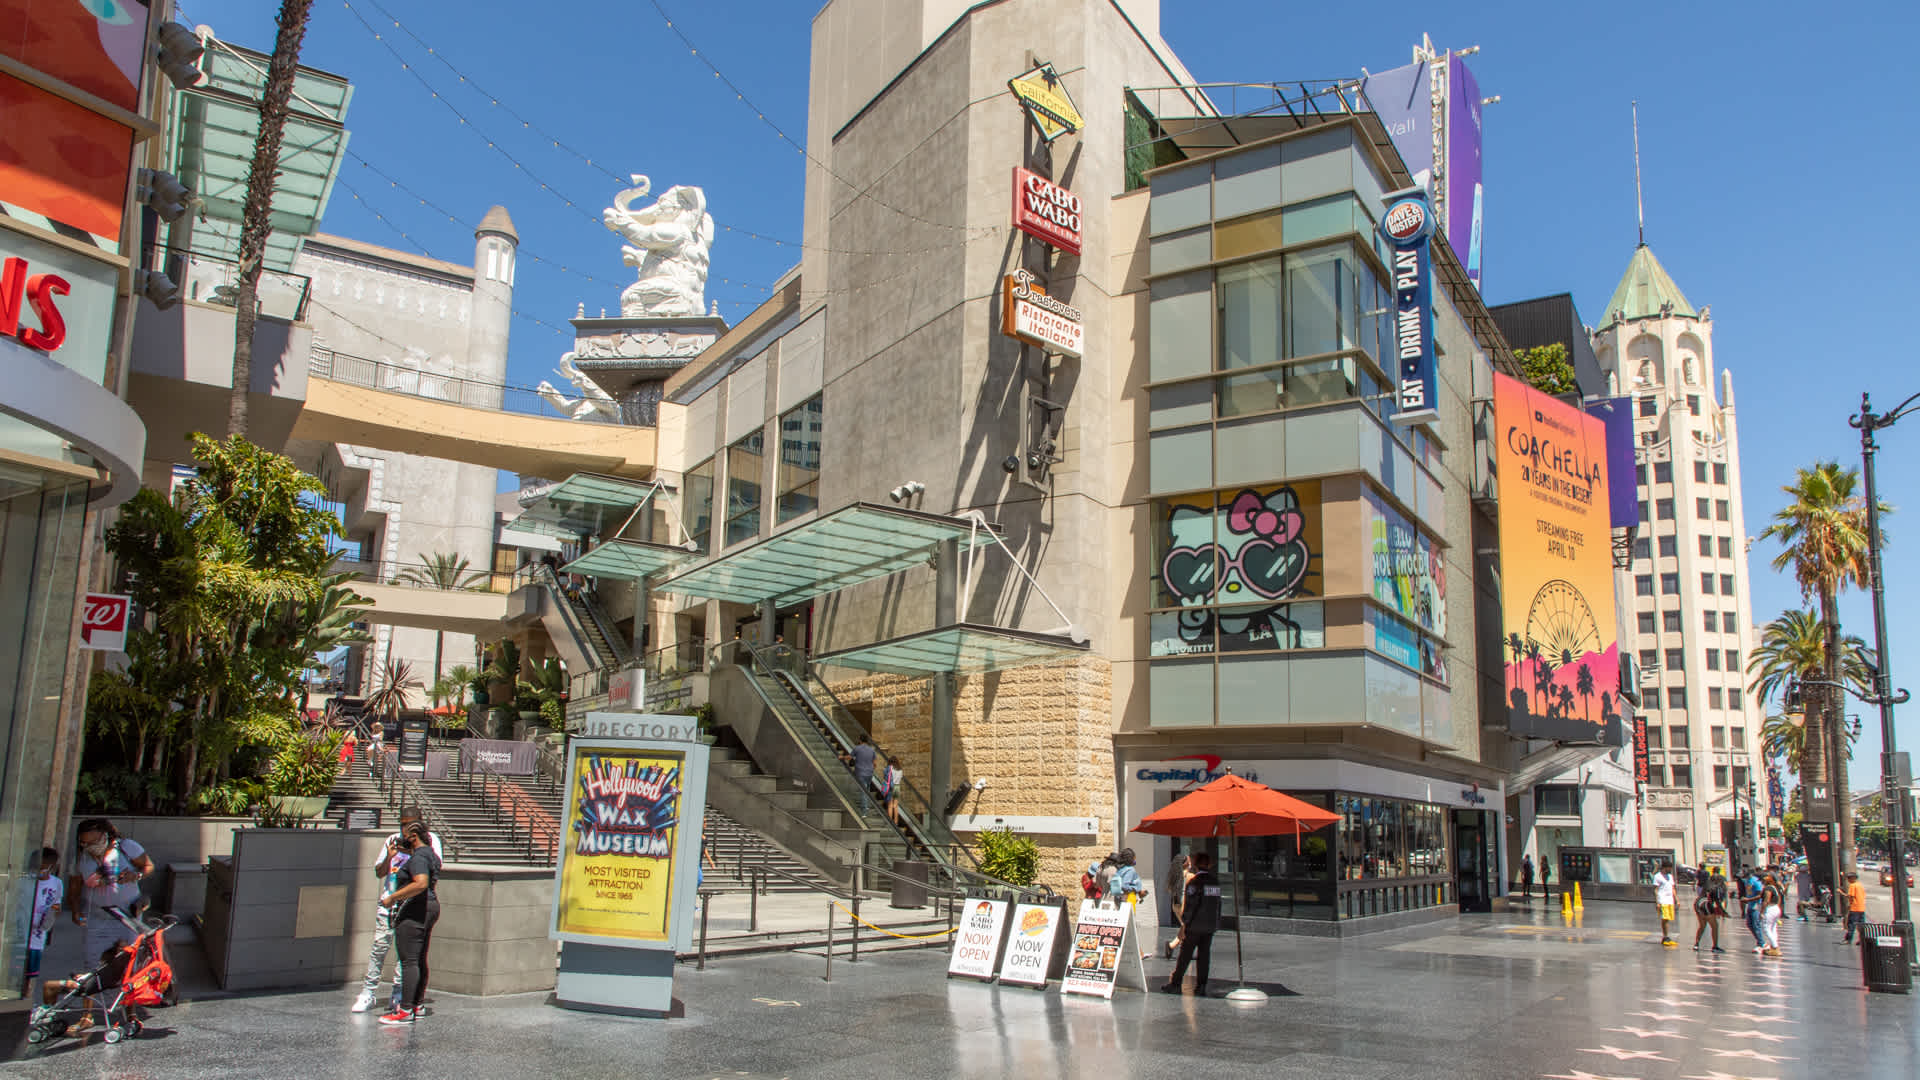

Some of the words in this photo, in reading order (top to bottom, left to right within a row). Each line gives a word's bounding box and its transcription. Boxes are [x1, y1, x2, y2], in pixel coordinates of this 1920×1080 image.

[1027, 175, 1081, 214] CABO
[1026, 192, 1081, 232] WABO
[1389, 205, 1412, 225] DAVE
[1025, 213, 1081, 243] CANTINA
[1396, 250, 1419, 291] PLAY
[1022, 304, 1081, 338] Ristorante
[1029, 320, 1074, 348] Italiano
[1399, 306, 1422, 360] DRINK
[1402, 379, 1424, 409] EAT
[1508, 426, 1602, 490] COACHELLA
[1521, 464, 1530, 482] 20
[1532, 467, 1552, 490] YEARS
[1552, 476, 1560, 494] IN
[1560, 479, 1571, 498] THE
[1572, 483, 1593, 507] DESERT
[1536, 519, 1569, 542] STREAMING
[1569, 530, 1584, 547] FREE
[1548, 539, 1567, 559] APRIL
[1567, 545, 1576, 561] 10
[578, 721, 695, 741] DIRECTORY
[586, 765, 667, 809] Hollywood
[1813, 786, 1827, 799] M
[596, 802, 648, 827] WAX
[577, 828, 669, 857] MUSEUM
[584, 866, 612, 877] MOST
[613, 867, 651, 879] VISITED
[587, 878, 643, 891] ATTRACTION
[595, 890, 616, 899] SINCE
[963, 932, 993, 946] NOW
[1015, 940, 1044, 953] NOW
[959, 946, 990, 961] OPEN
[1010, 955, 1042, 968] OPEN
